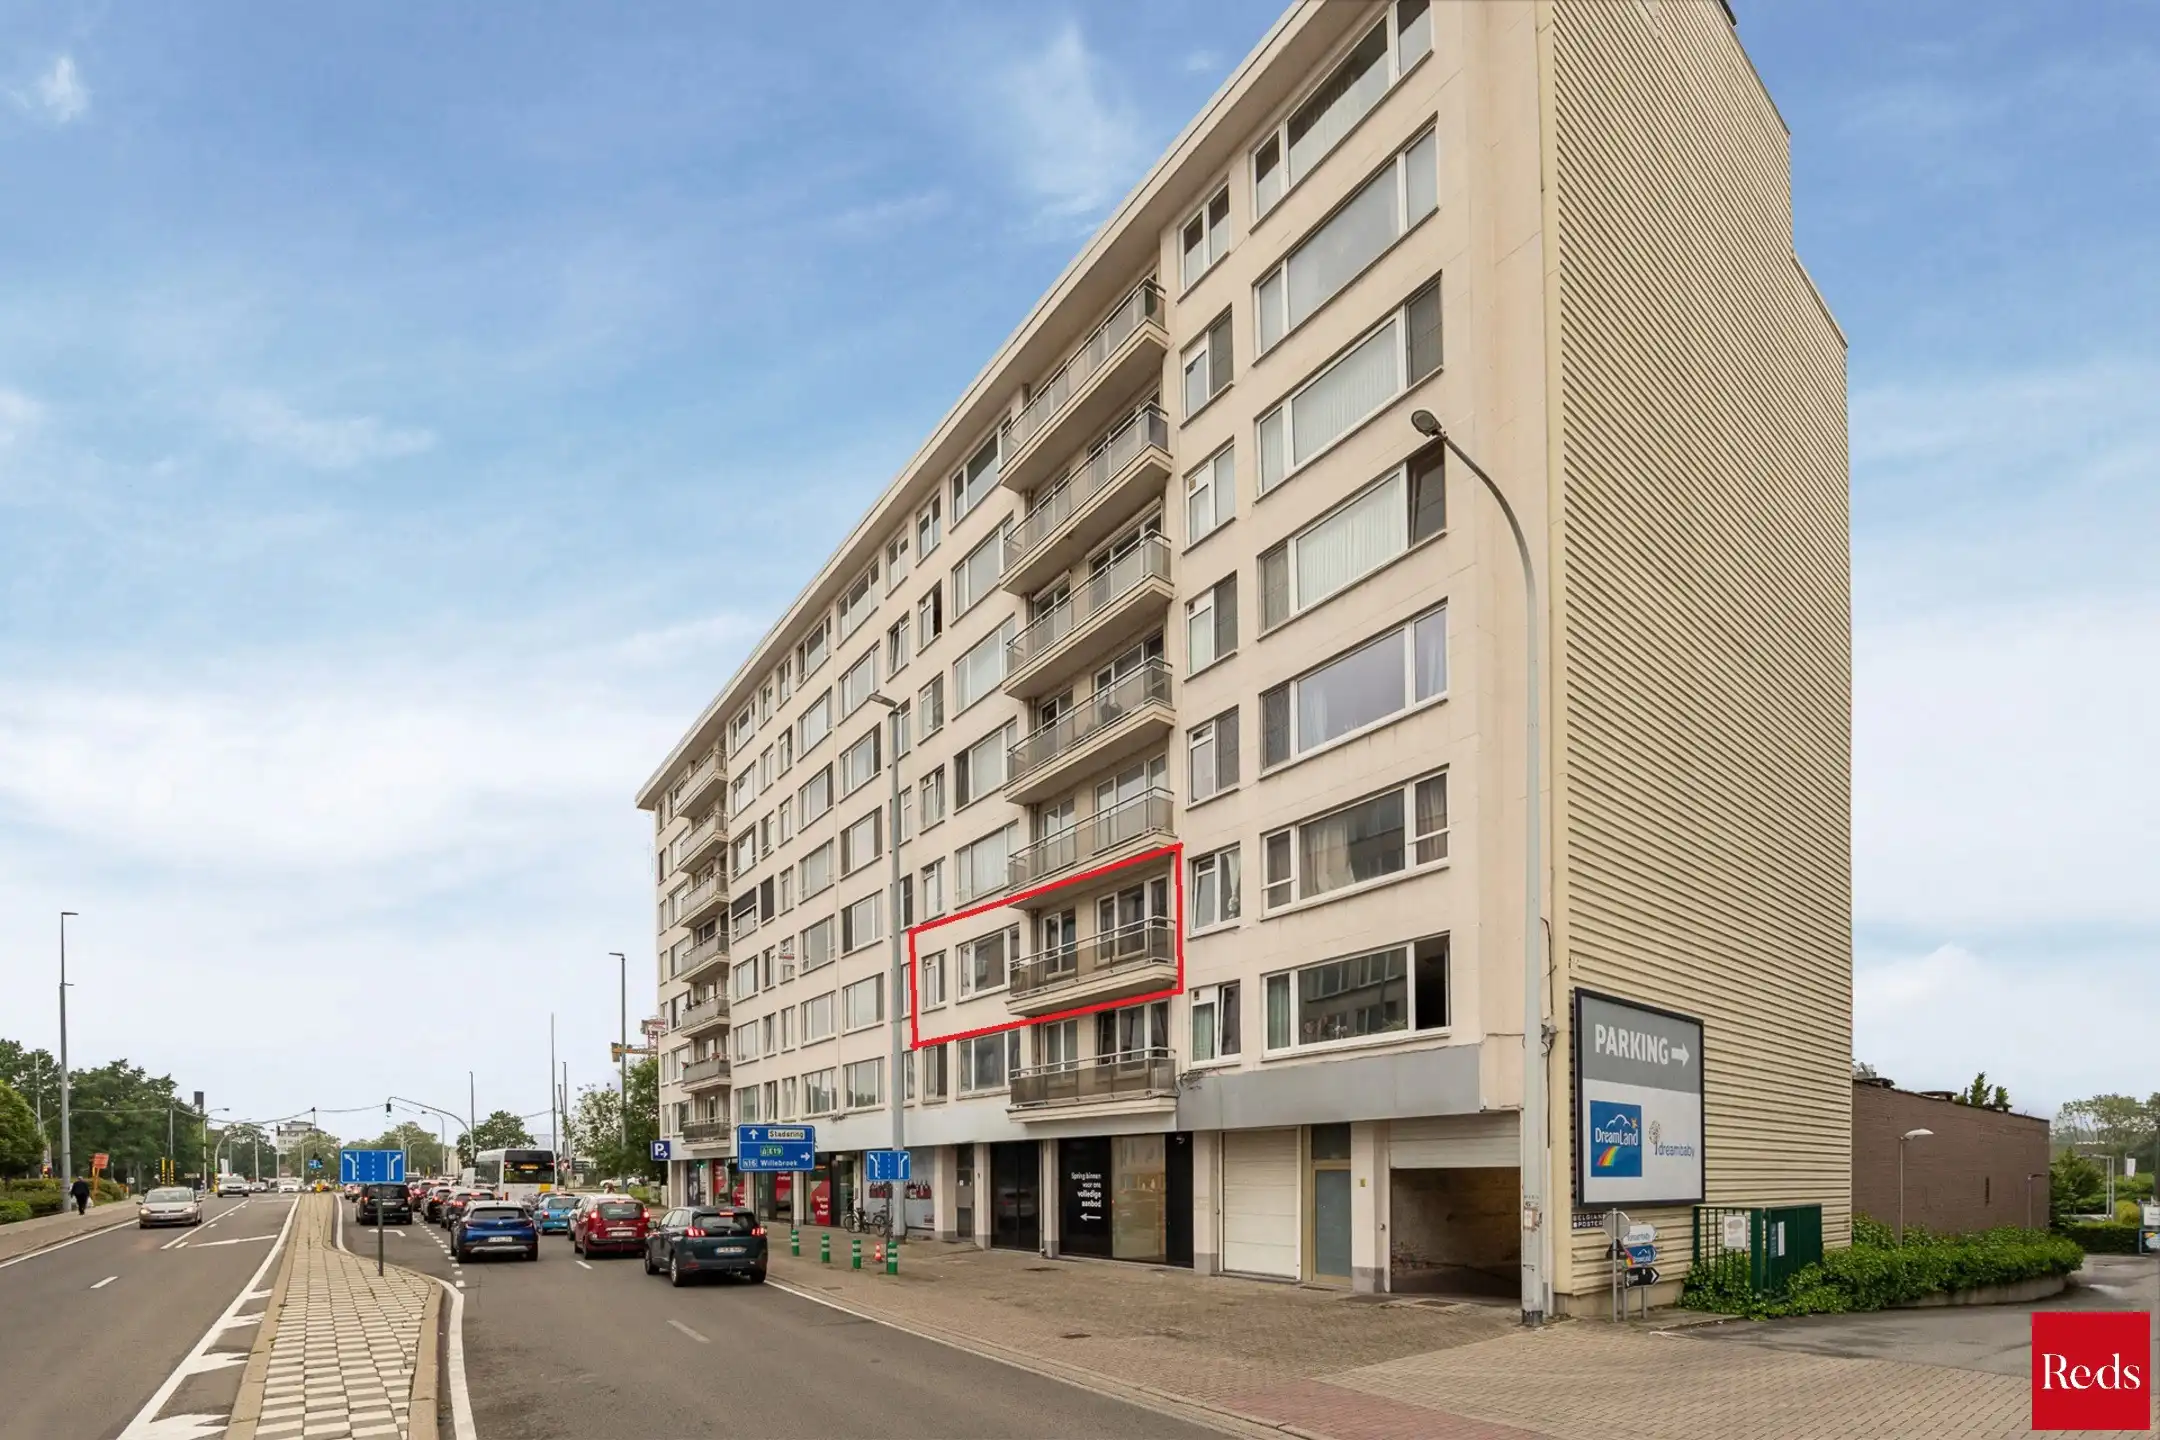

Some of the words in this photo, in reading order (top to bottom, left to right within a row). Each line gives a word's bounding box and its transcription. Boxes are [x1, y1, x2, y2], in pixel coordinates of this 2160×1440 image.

[1594, 1024, 1669, 1065] PARKING
[769, 1130, 803, 1139] Stadsring
[1595, 1127, 1639, 1146] DreamLand
[654, 1143, 665, 1157] P
[1658, 1141, 1695, 1160] dreambaby
[760, 1160, 798, 1168] Willebroek
[1077, 1189, 1101, 1199] volledige
[1081, 1199, 1101, 1207] aanbod
